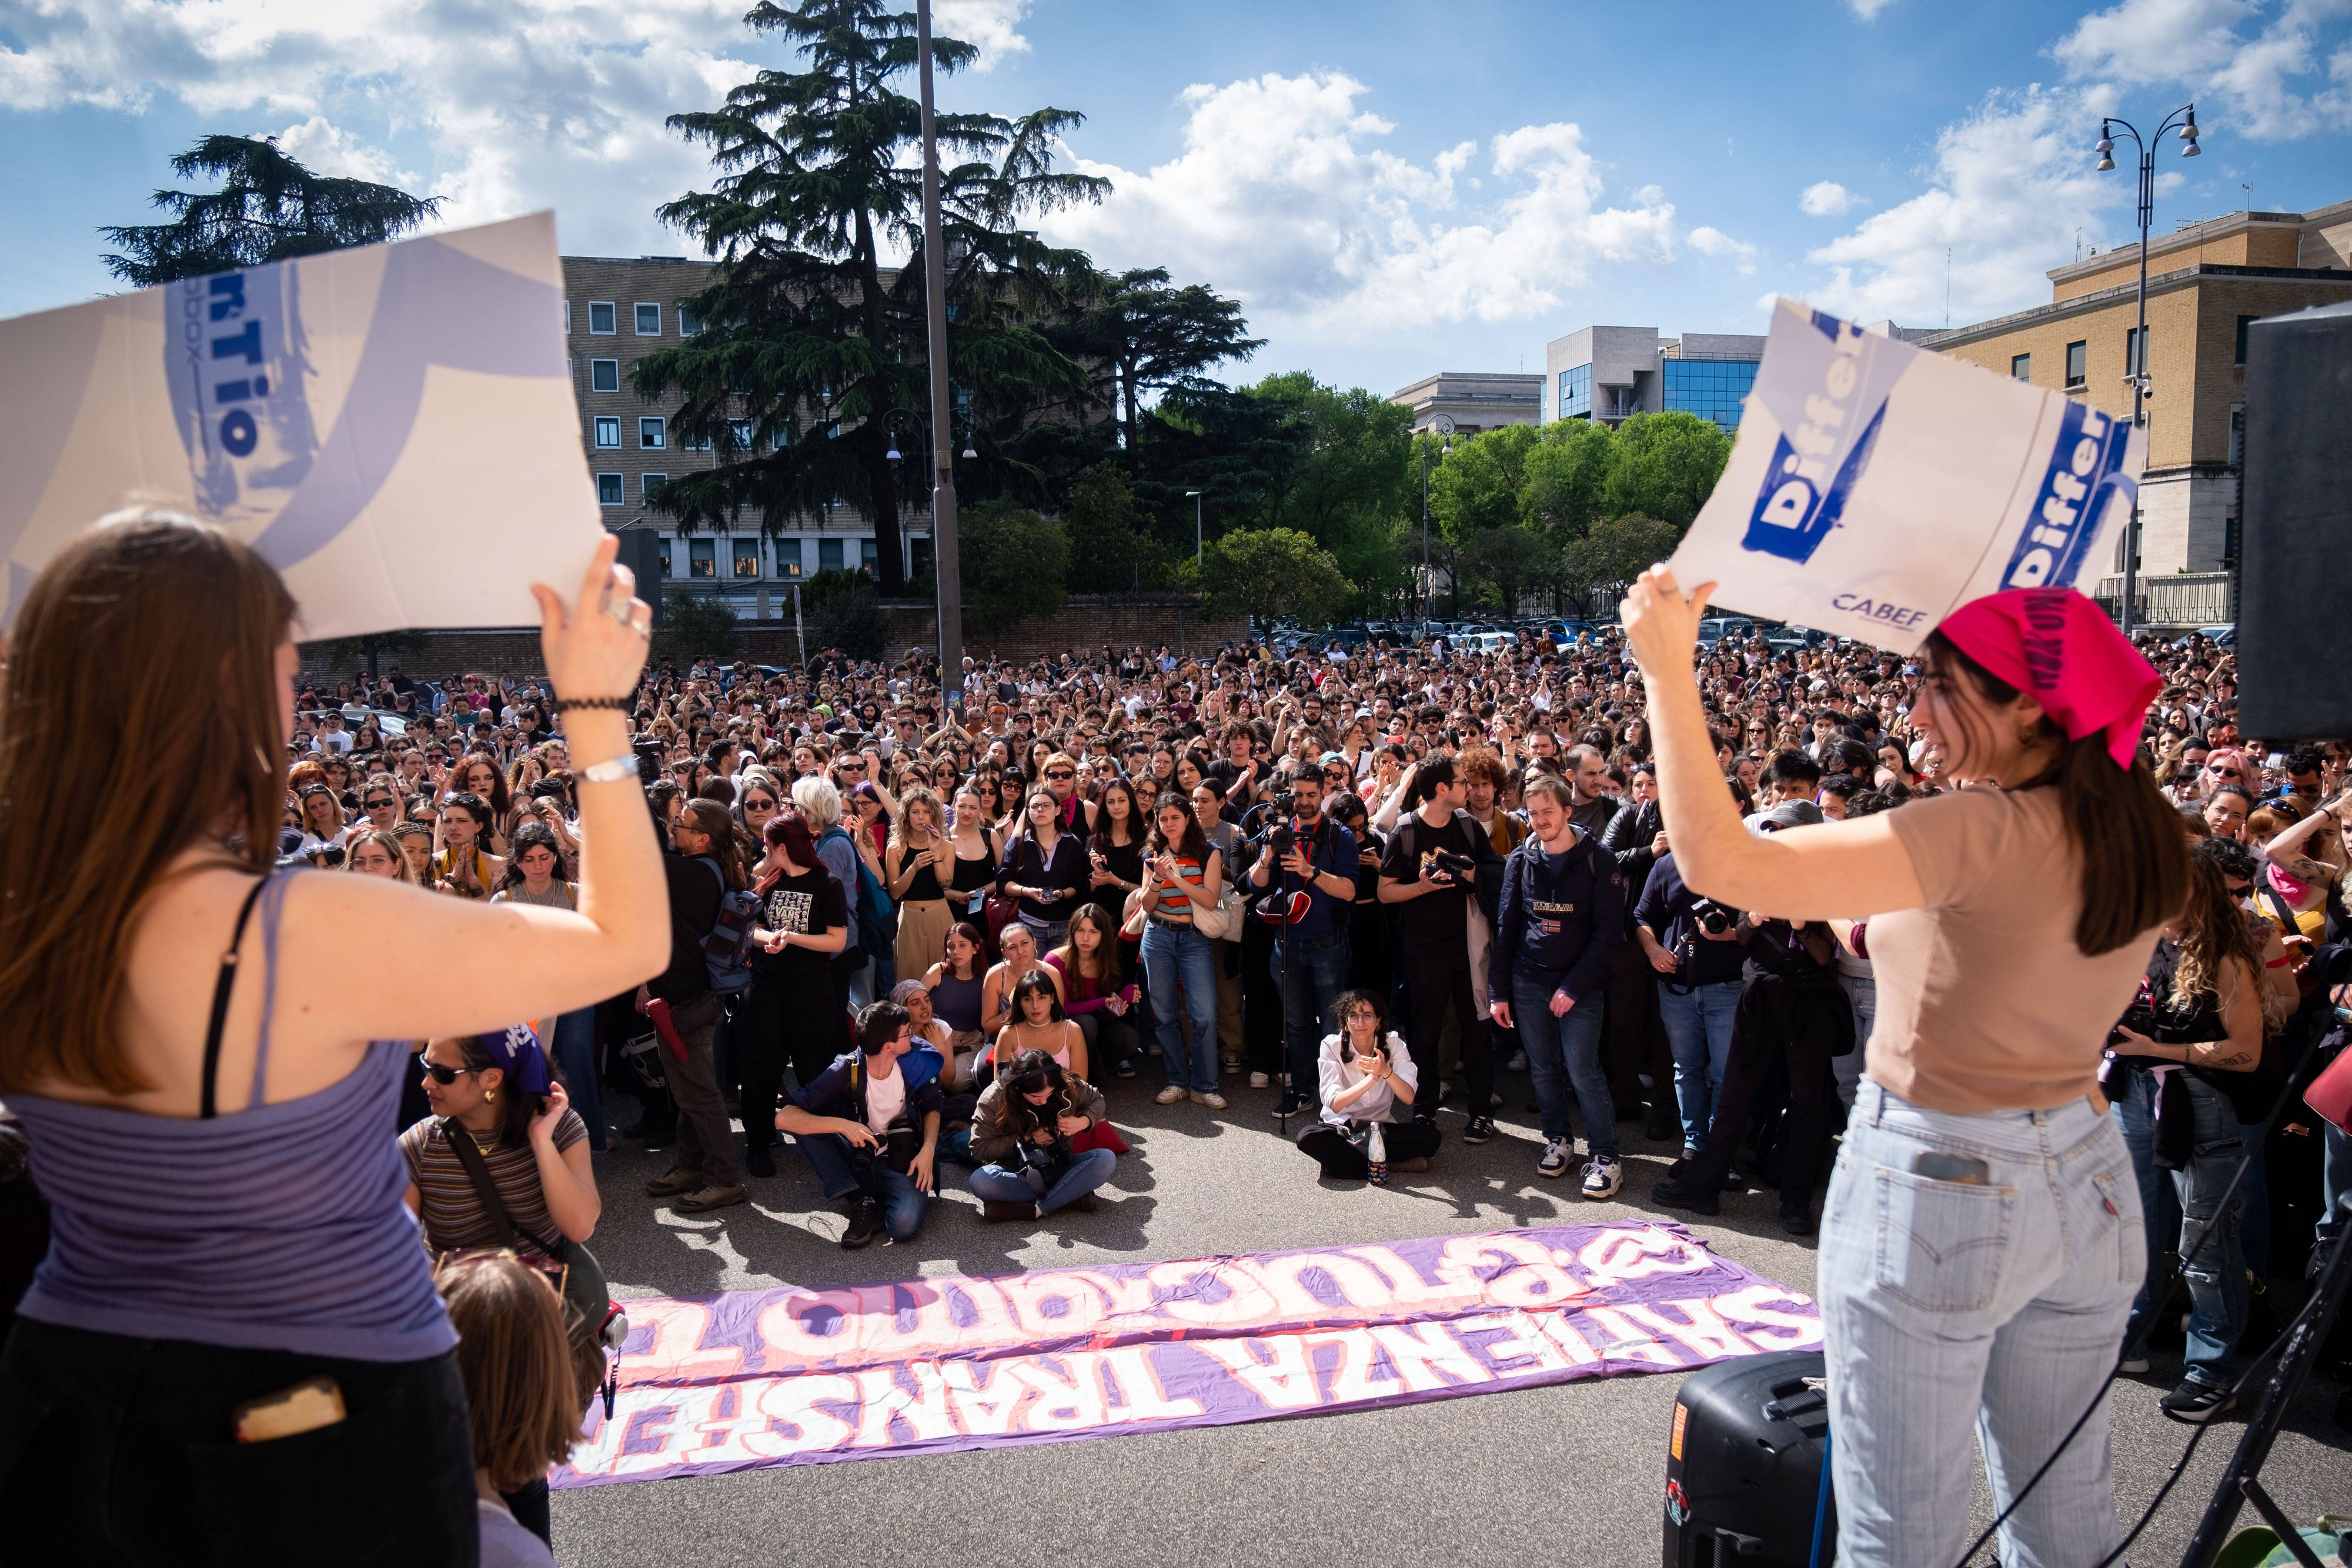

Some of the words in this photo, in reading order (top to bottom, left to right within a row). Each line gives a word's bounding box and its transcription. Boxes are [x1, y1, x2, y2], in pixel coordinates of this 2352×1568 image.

[1832, 593, 1928, 626] CABEF
[775, 905, 802, 920] VANS
[1197, 1285, 1825, 1406] SAPIENZA
